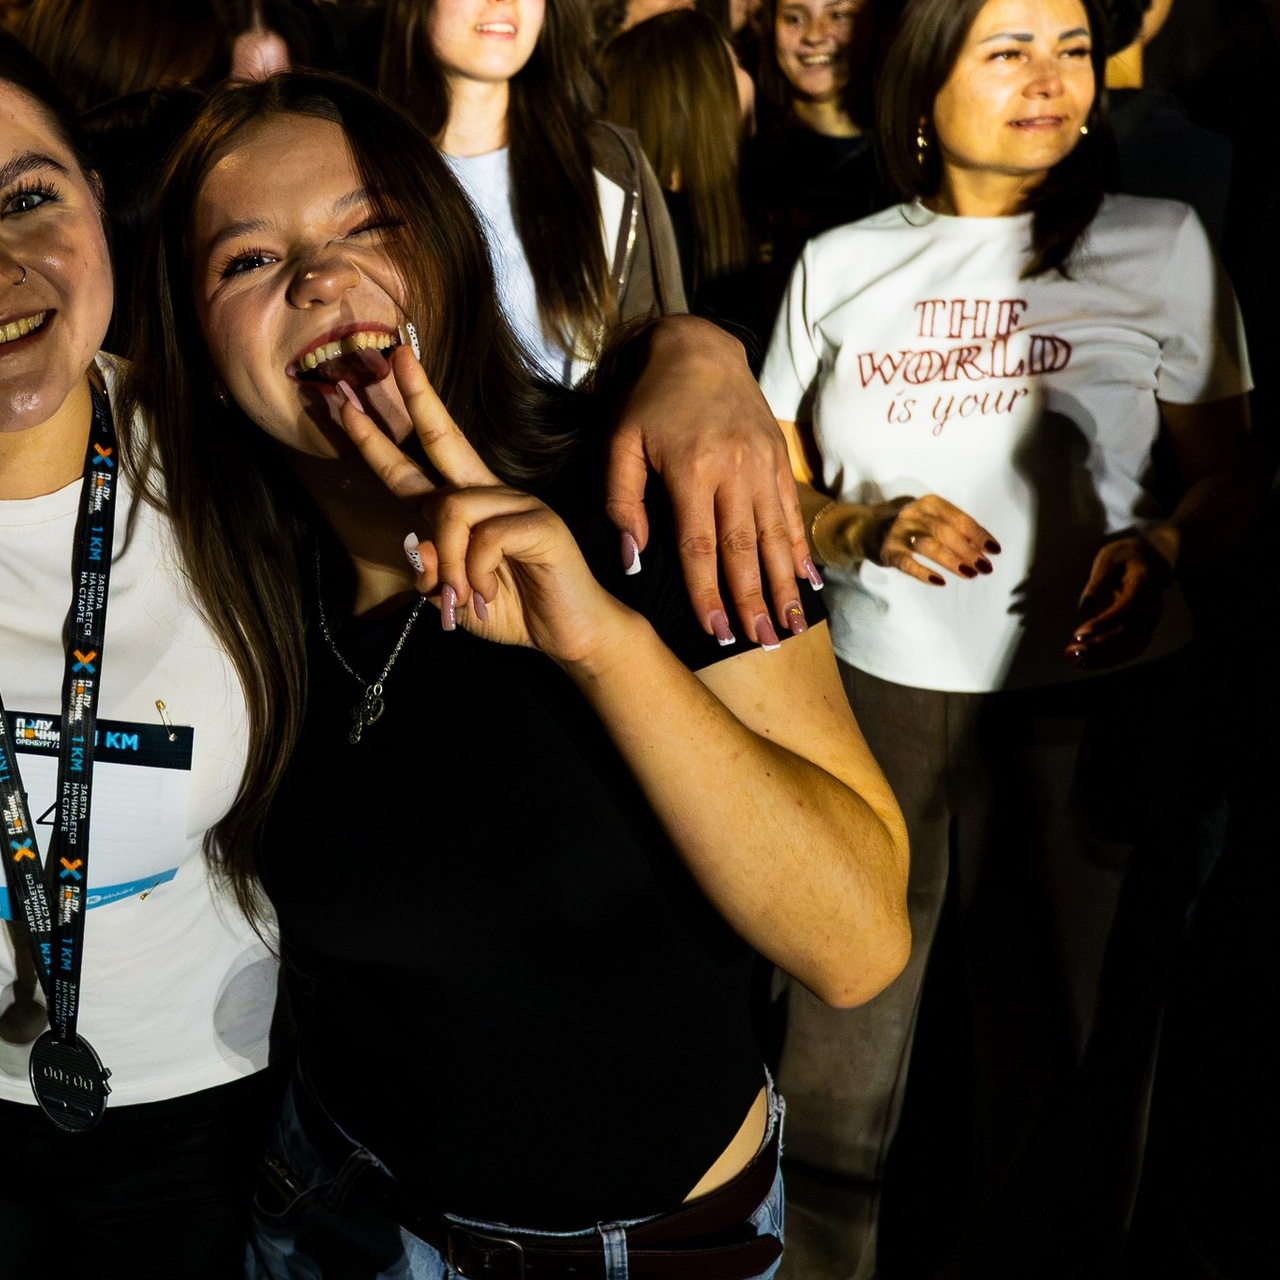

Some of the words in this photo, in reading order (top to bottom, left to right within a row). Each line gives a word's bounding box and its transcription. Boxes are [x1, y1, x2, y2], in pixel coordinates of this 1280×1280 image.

[914, 299, 1028, 339] THE
[857, 335, 1072, 389] WORLD
[886, 390, 916, 424] is
[932, 387, 1029, 437] your
[81, 571, 88, 585] НА
[96, 573, 106, 610] ЗАВТРА
[77, 587, 86, 623] СТАРТЕ
[84, 572, 96, 636] НАЧИНАЕТСЯ
[16, 728, 60, 741] НОЧНИ
[63, 782, 70, 795] НА
[79, 784, 88, 819] ЗАВТРА
[61, 797, 70, 832] СТАРТЕ
[69, 783, 79, 845] НАЧИНАЕТСЯ
[25, 873, 45, 932] НАЧИНАЕТСЯ
[26, 898, 37, 932] ЗАВТРА
[37, 883, 50, 917] СТАРТЕ
[46, 920, 52, 932] НА
